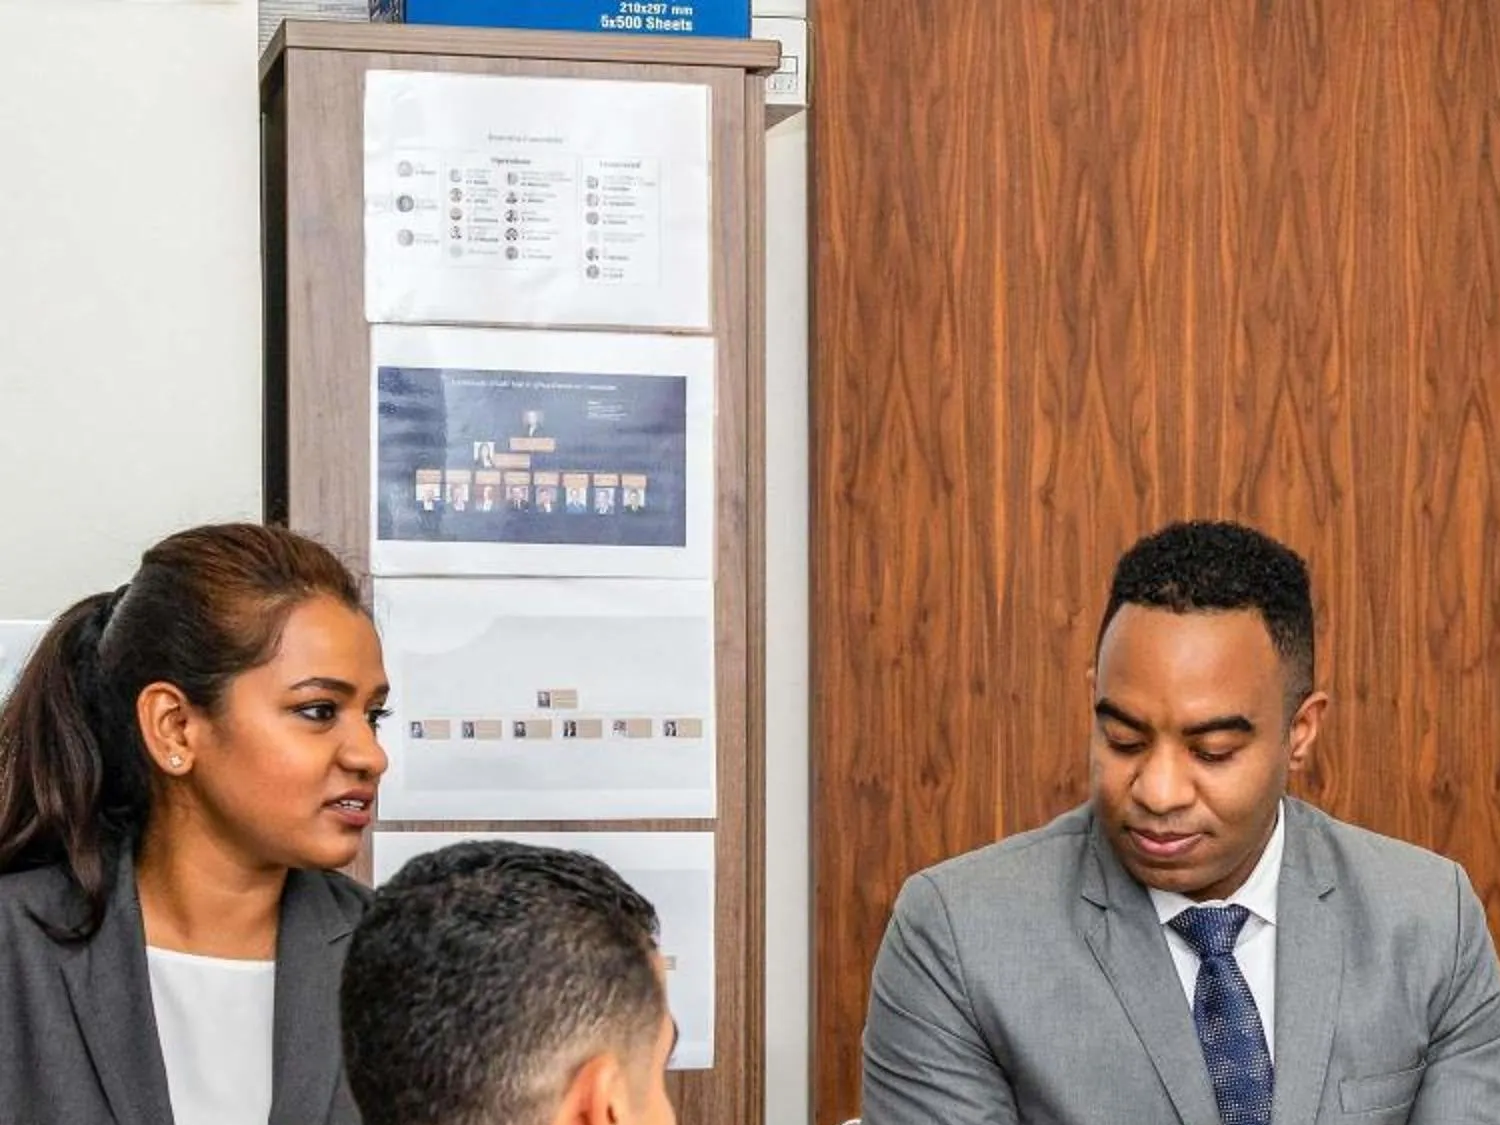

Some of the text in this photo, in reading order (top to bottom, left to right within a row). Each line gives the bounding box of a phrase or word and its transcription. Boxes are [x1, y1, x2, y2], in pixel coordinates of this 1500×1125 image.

[620, 2, 693, 15] 210x297 mm
[601, 15, 693, 31] 5x500 Sheets
